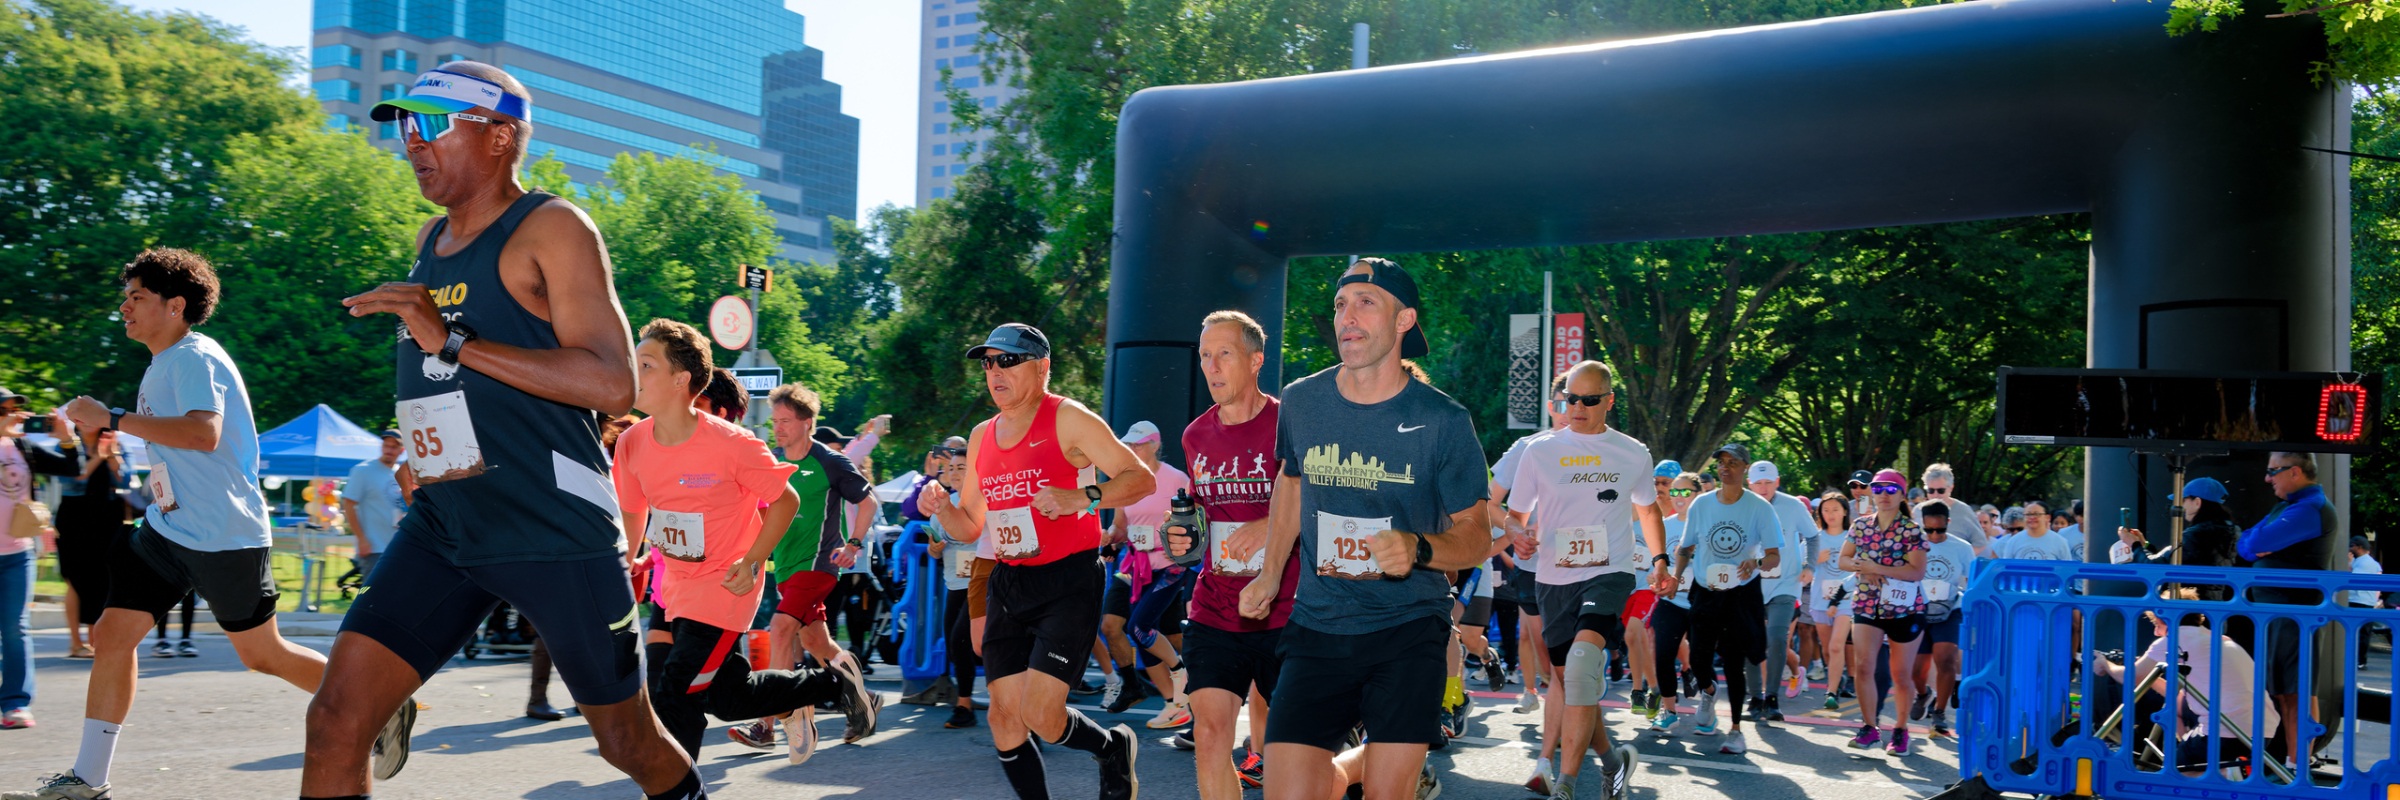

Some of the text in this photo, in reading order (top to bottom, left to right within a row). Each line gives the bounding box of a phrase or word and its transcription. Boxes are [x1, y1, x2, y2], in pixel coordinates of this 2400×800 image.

[756, 377, 775, 389] WAY
[2316, 385, 2366, 441] 0
[412, 426, 443, 459] 85
[1560, 455, 1602, 467] CHIPS
[982, 468, 1042, 486] RIVER CITY
[1304, 464, 1386, 479] SACRAMENTO
[1570, 472, 1620, 483] RACING
[1217, 482, 1272, 495] ROCKLIN
[1308, 474, 1378, 491] VALLEY ENDURANCE
[663, 526, 687, 546] 171
[997, 525, 1022, 545] 329
[1333, 536, 1371, 561] 125
[1568, 539, 1594, 555] 371
[1718, 573, 1729, 583] 10
[1891, 589, 1907, 600] 178
[1930, 587, 1936, 595] 4
